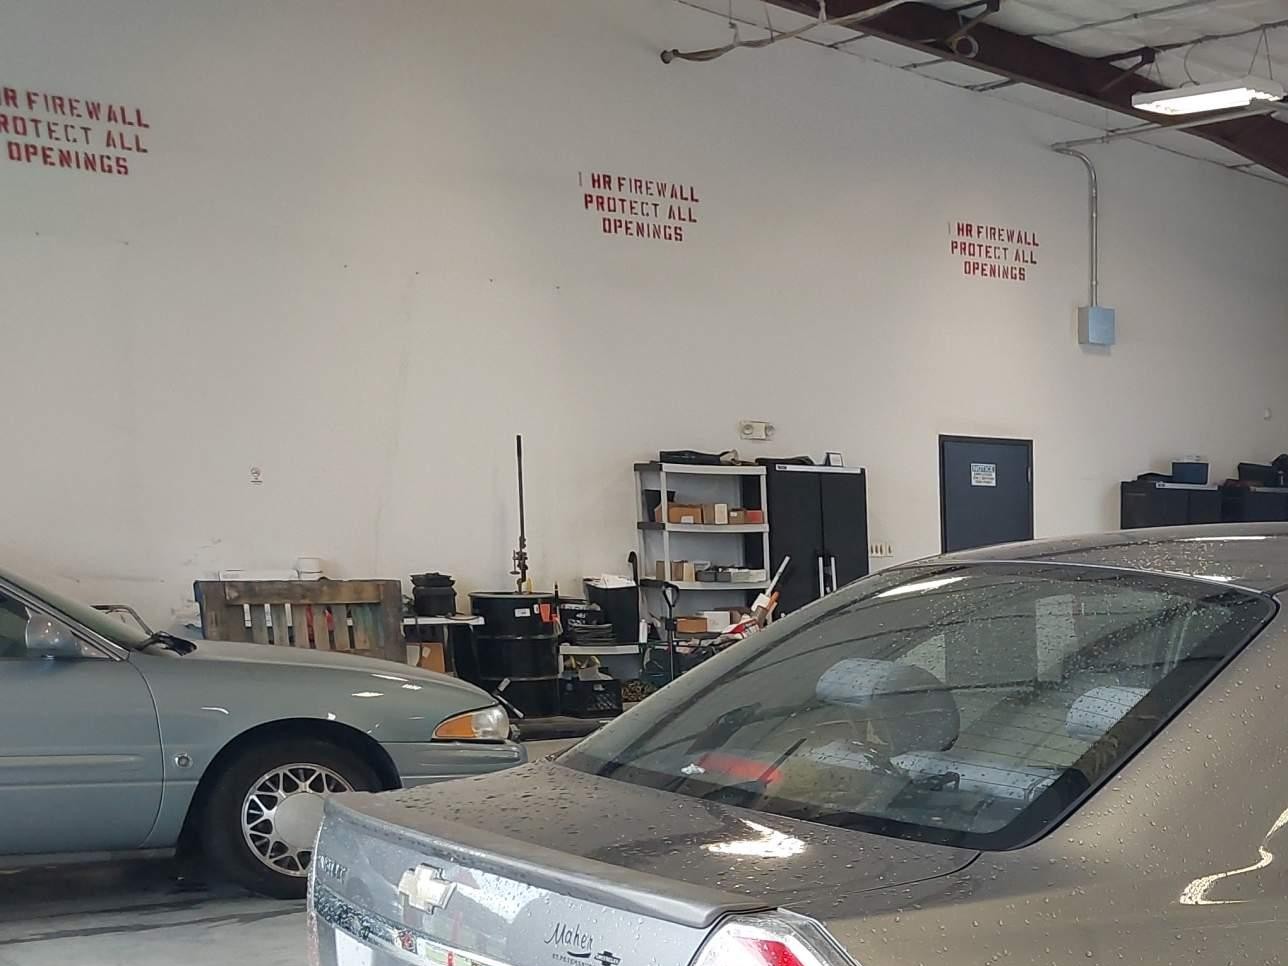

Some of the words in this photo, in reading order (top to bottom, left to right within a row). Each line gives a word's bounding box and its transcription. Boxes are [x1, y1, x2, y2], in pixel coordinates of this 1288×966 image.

[0, 86, 18, 109] R
[26, 91, 150, 128] FIREWALL
[0, 113, 92, 145] ROTECT
[106, 130, 149, 153] ALL
[7, 140, 129, 175] OPENINGS
[591, 172, 612, 191] HR
[617, 176, 700, 203] FIREWALL
[584, 193, 660, 218] PROTECT
[667, 204, 698, 223] ALL
[602, 217, 683, 242] OPENINGS
[956, 222, 973, 238] HR
[976, 225, 1040, 247] FIREWALL
[951, 240, 1009, 261] PROTECT
[1014, 248, 1038, 265] ALL
[964, 261, 1026, 281] OPENINGS
[544, 922, 593, 951] Maher
